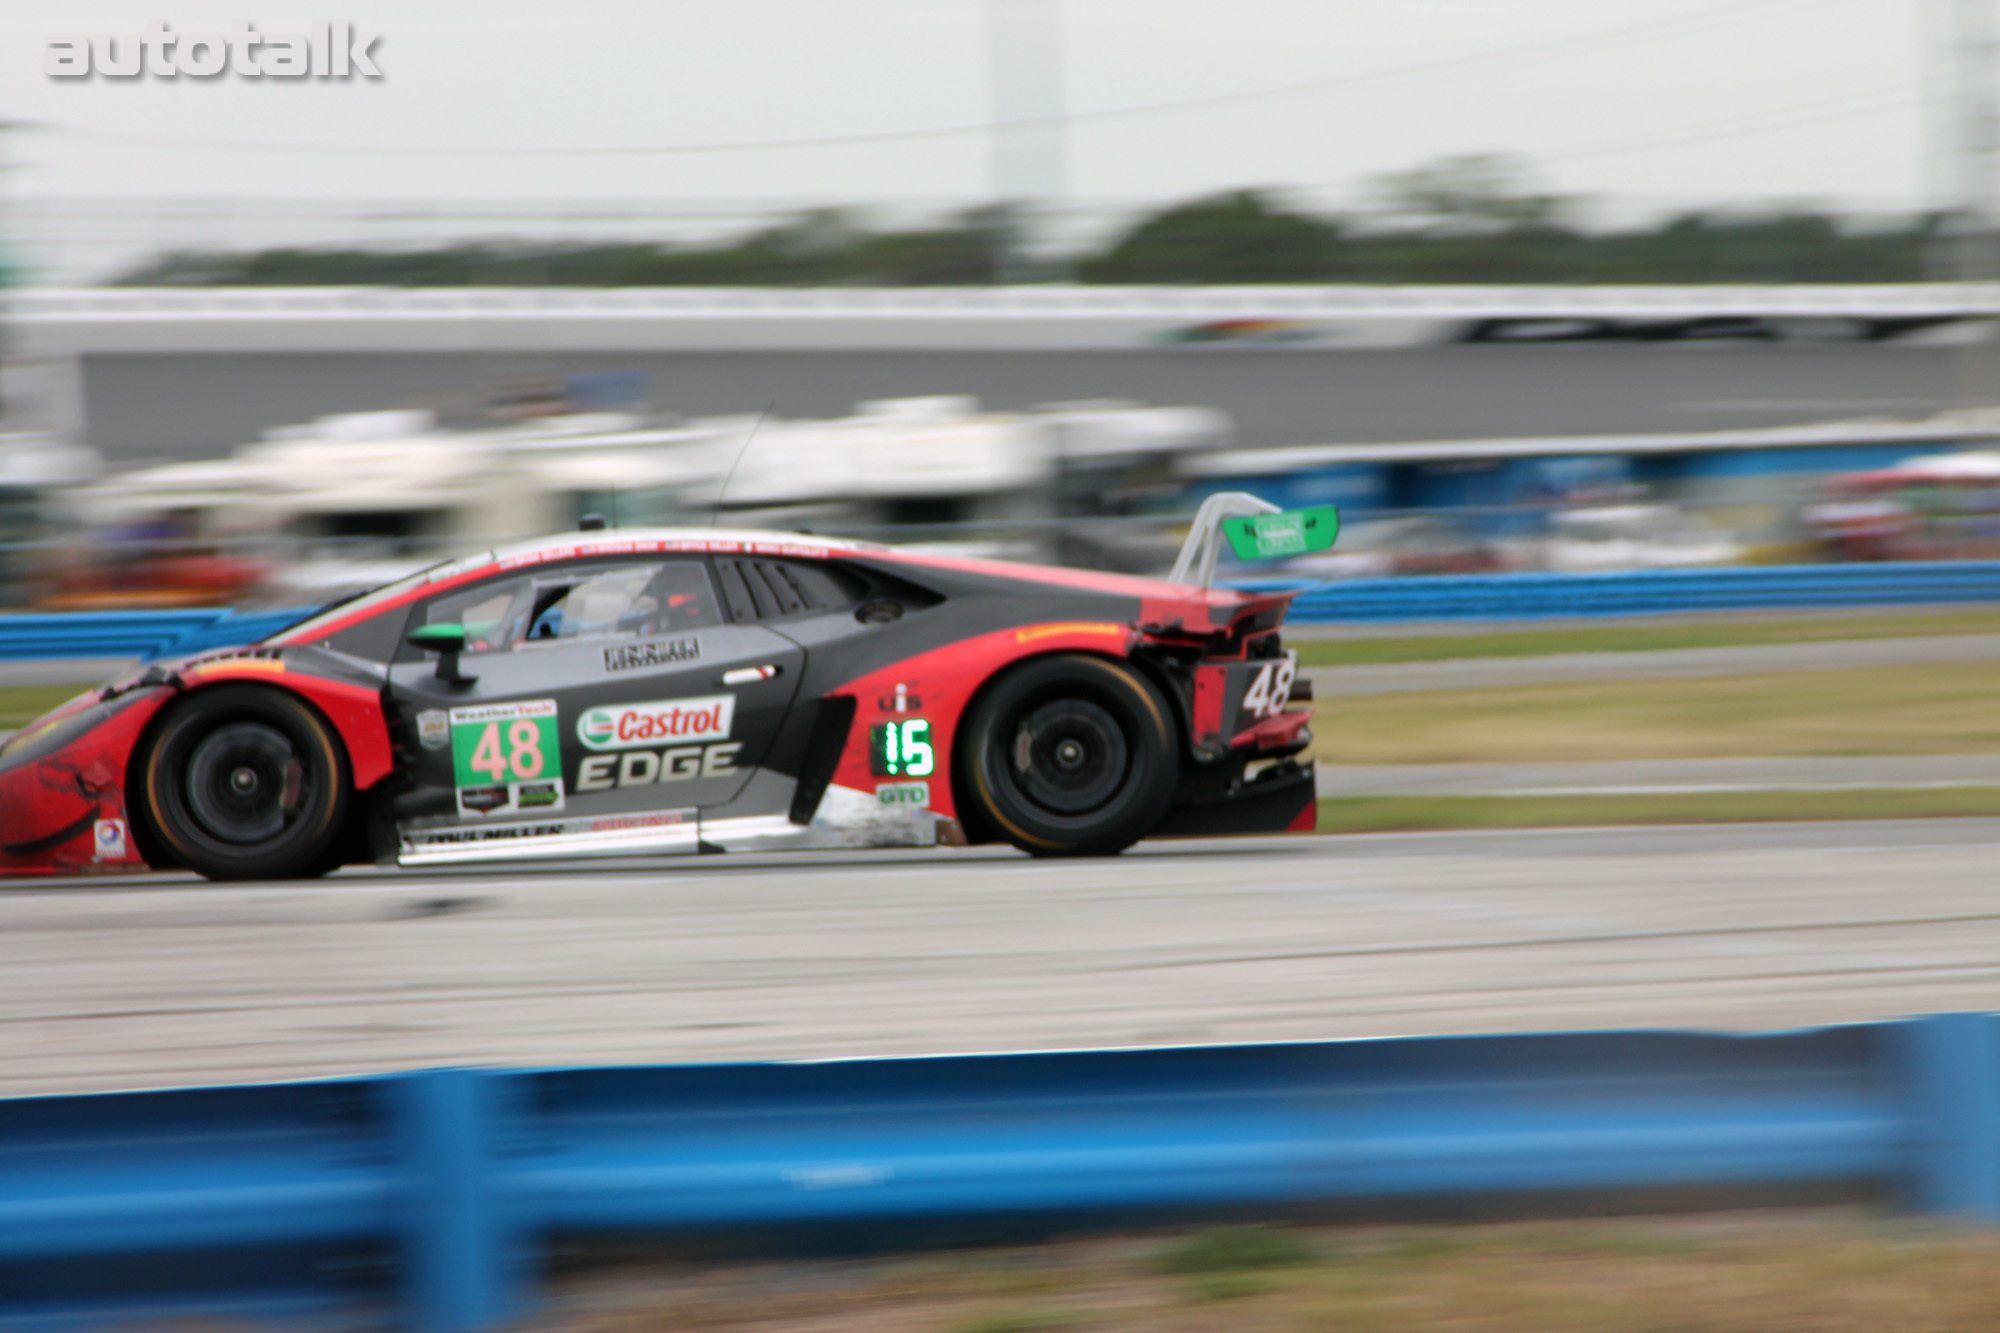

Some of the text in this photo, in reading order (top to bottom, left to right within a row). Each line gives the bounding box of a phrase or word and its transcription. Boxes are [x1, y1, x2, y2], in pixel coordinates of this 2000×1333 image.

[1243, 661, 1296, 718] 48
[618, 704, 721, 741] Castrol
[886, 719, 934, 776] 15
[470, 719, 544, 782] 48
[577, 743, 742, 791] EDGE
[879, 786, 926, 804] GTD
